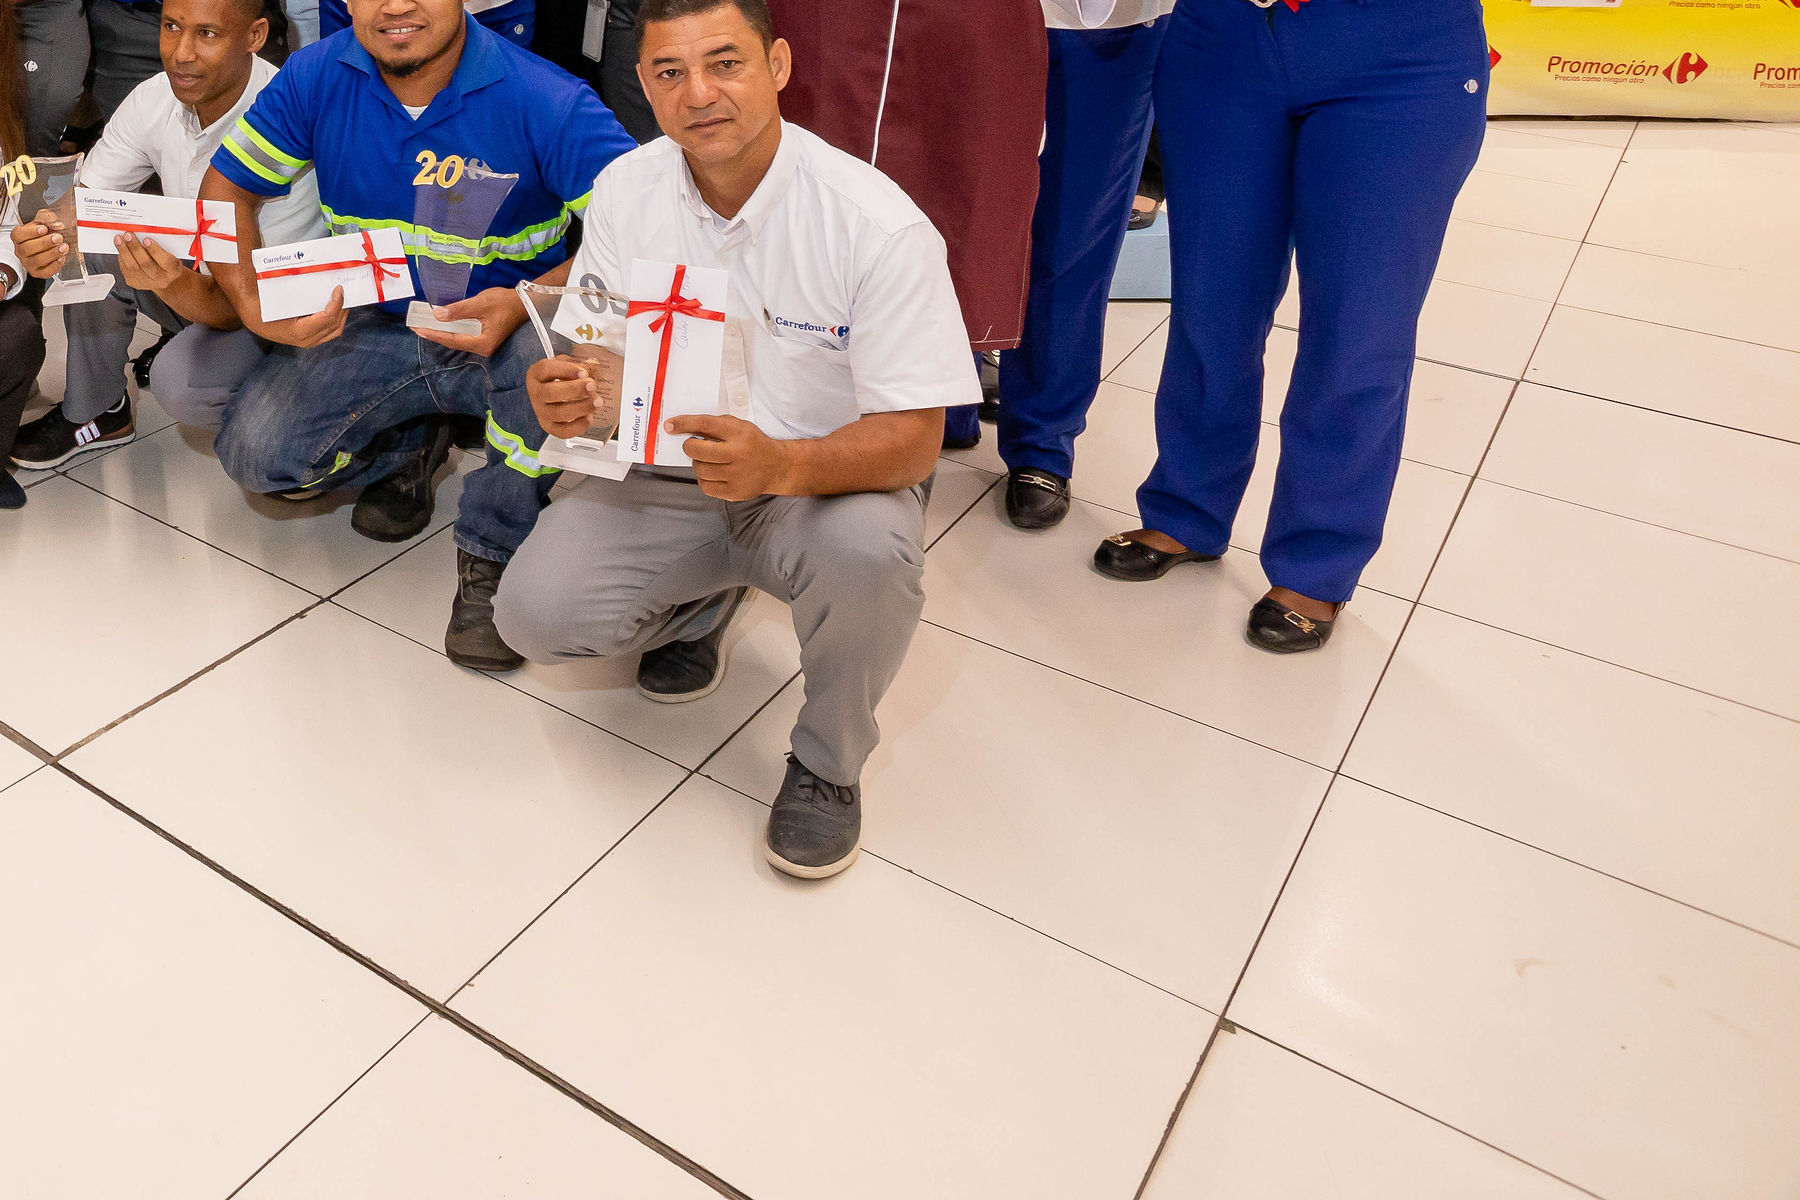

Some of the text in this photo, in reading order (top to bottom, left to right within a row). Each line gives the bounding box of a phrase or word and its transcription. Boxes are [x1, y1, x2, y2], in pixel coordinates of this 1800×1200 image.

[1668, 0, 1694, 8] Precios
[1547, 55, 1659, 77] Promoción
[1554, 74, 1580, 82] Precios
[1581, 75, 1601, 83] como
[1629, 76, 1645, 84] otro
[0, 154, 36, 198] 20
[412, 149, 465, 189] 20
[84, 197, 113, 205] Carrefour
[263, 254, 292, 265] Carrefour
[775, 316, 828, 333] Carrefour
[631, 414, 641, 452] Carrefour
